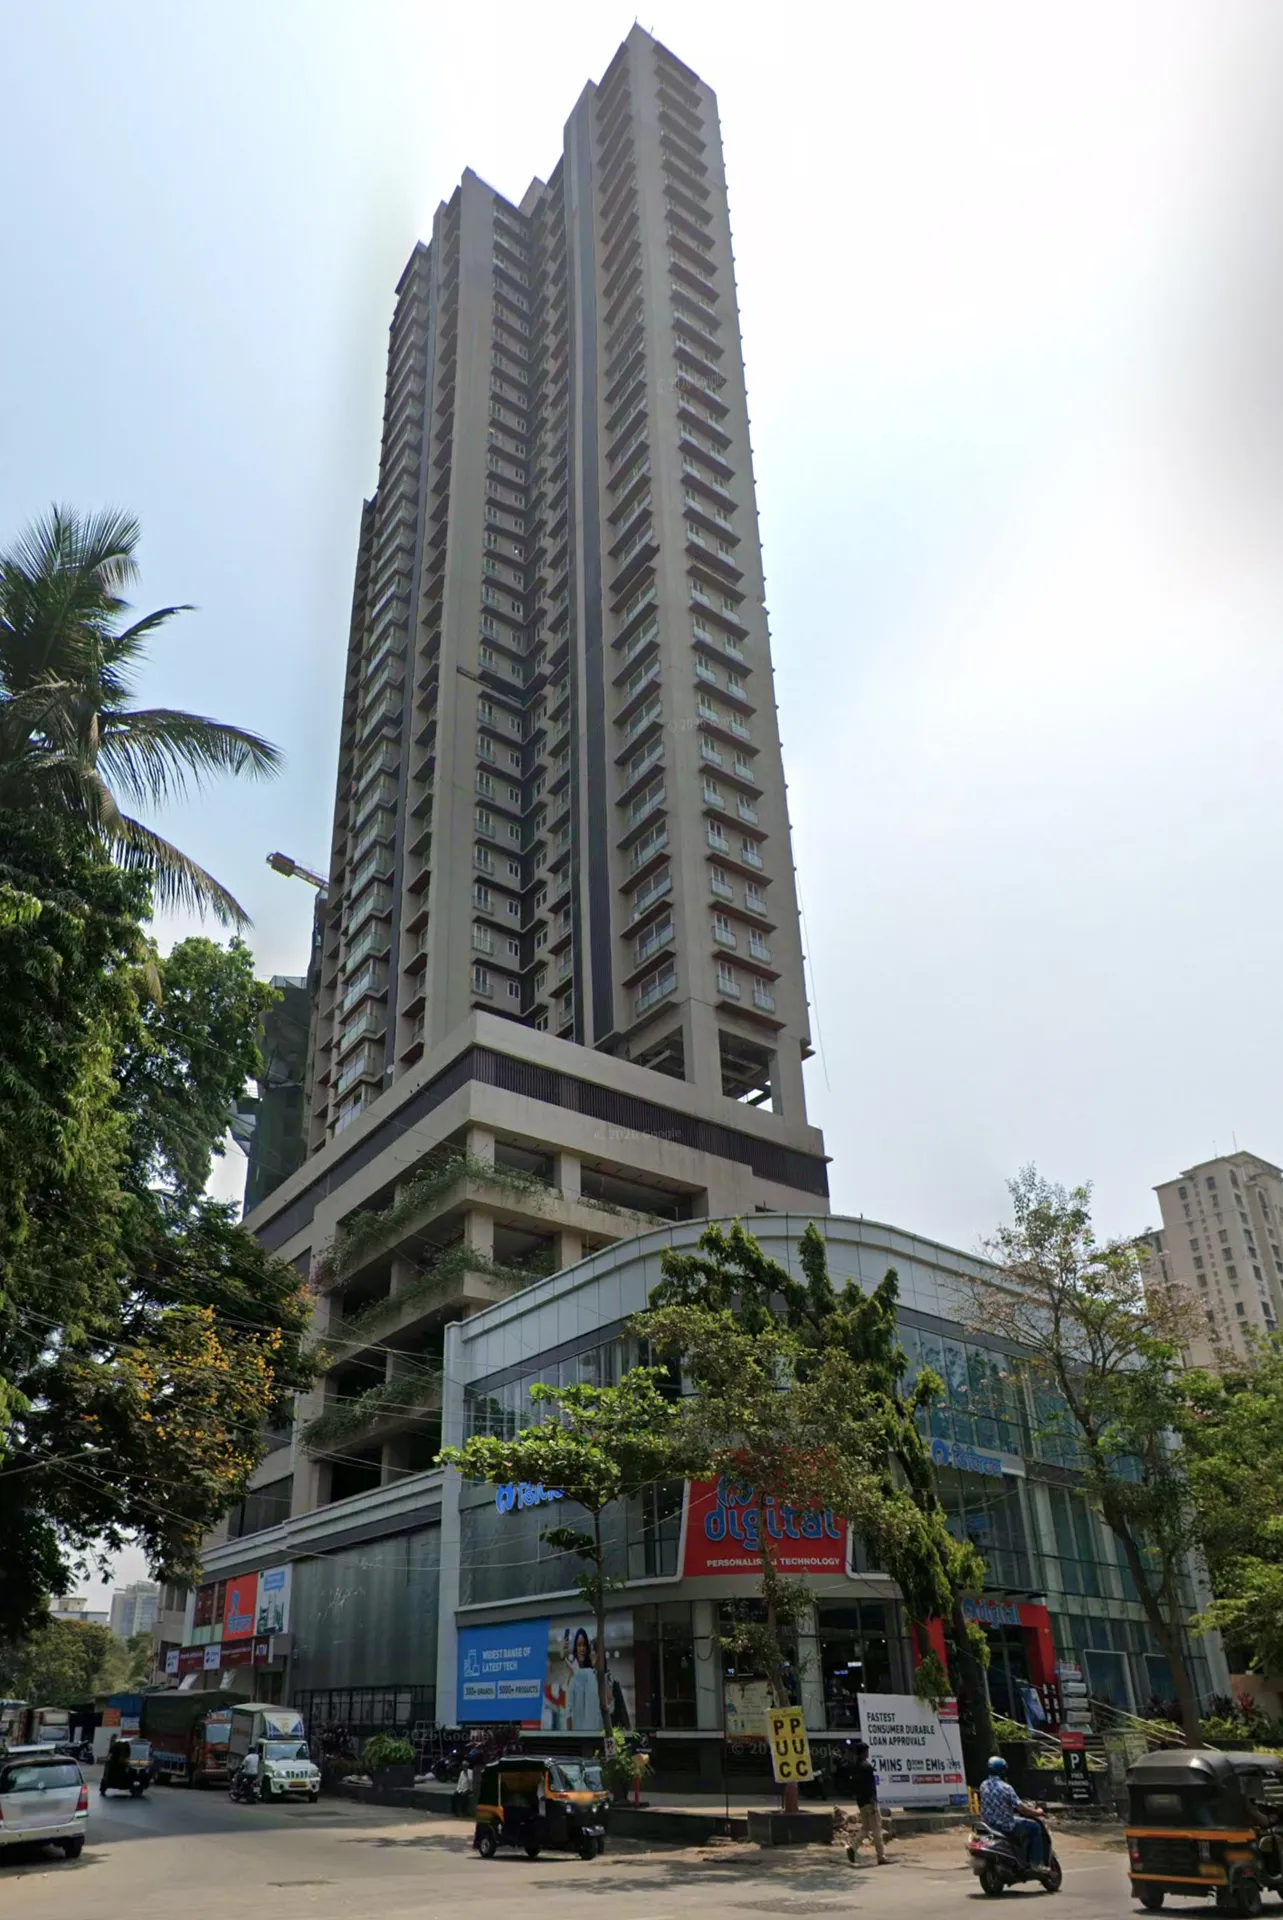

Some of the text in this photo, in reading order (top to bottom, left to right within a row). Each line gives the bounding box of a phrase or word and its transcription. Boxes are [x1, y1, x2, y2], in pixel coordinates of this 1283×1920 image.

[704, 1497, 841, 1552] digital
[707, 1557, 840, 1568] PERSONALIS TECHNOLOGY
[523, 1647, 531, 1657] OF
[482, 1660, 518, 1673] LATEST TECH
[515, 1685, 539, 1694] PRODUCTS
[867, 1712, 895, 1722] FASTEST
[868, 1723, 935, 1735] CONSUMER DURABLE
[869, 1736, 926, 1746] LOAN APPROVALS
[871, 1759, 877, 1772] 2
[879, 1758, 903, 1772] MINS
[925, 1758, 945, 1771] EMIs
[1070, 1753, 1080, 1769] P
